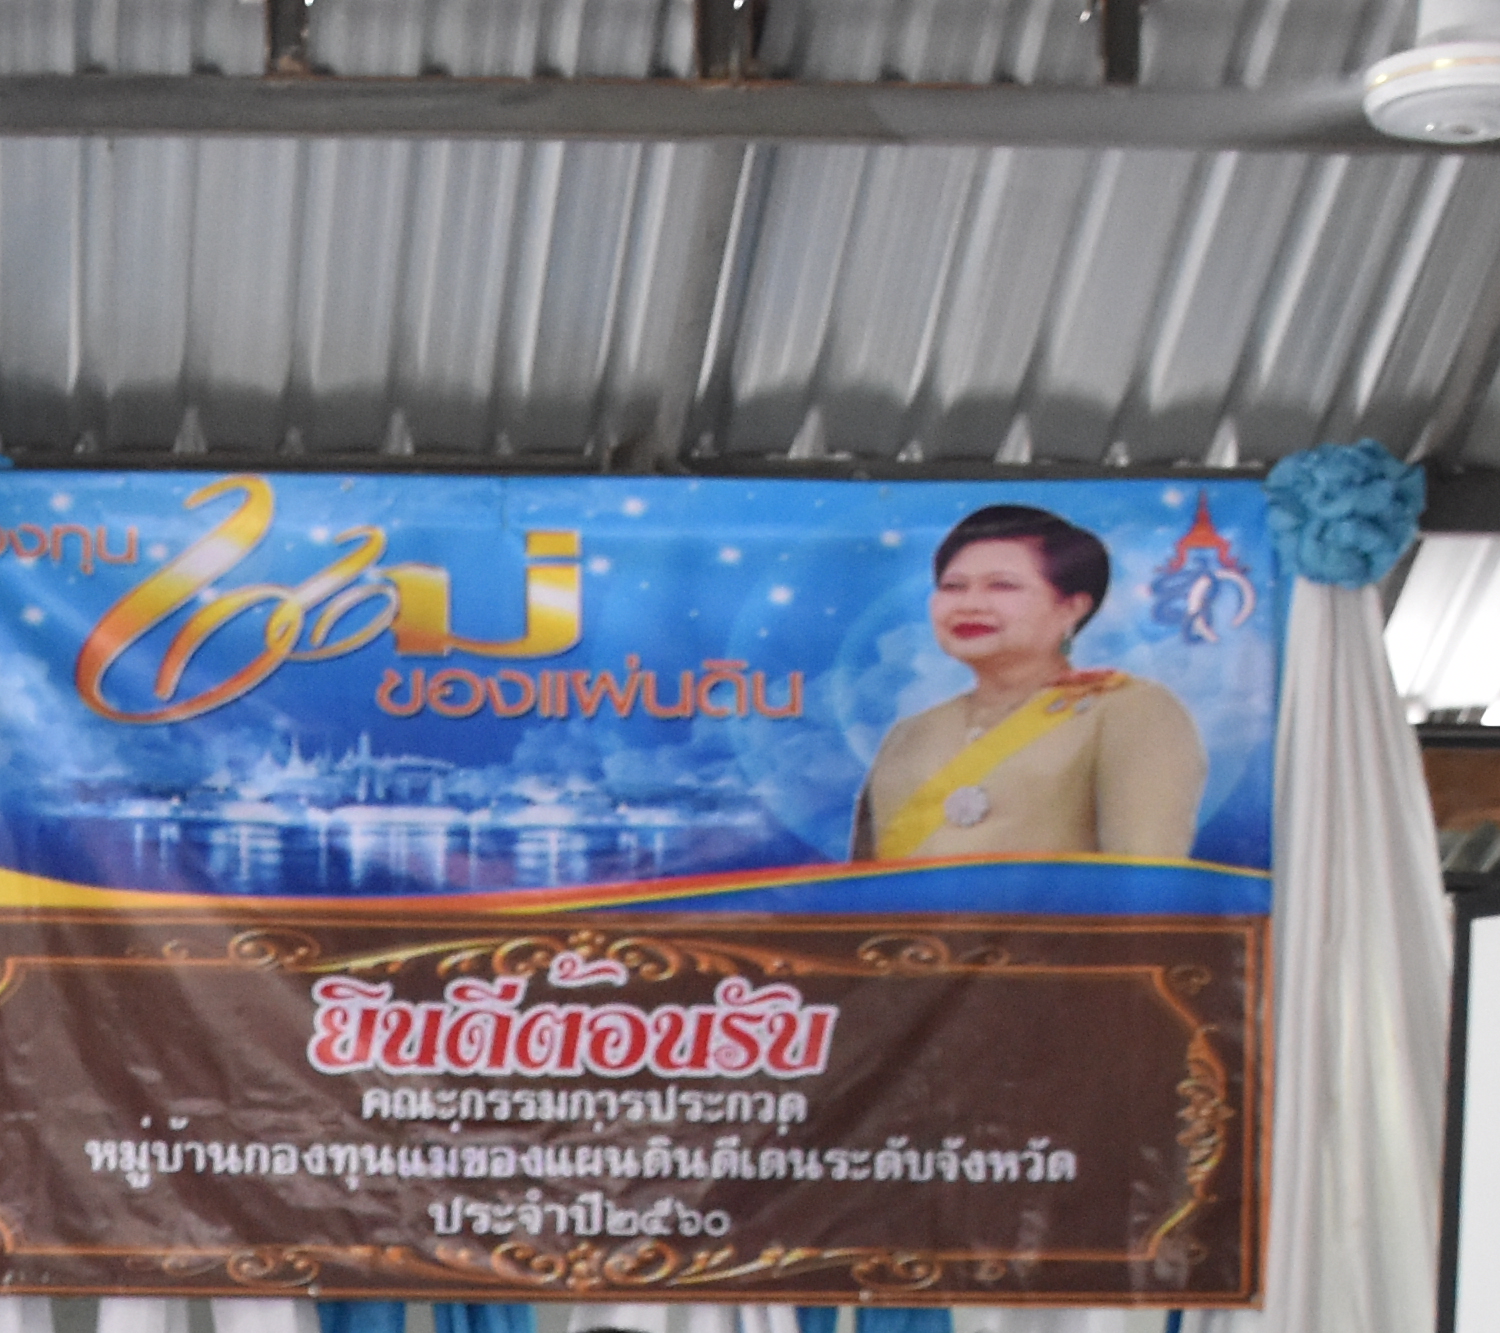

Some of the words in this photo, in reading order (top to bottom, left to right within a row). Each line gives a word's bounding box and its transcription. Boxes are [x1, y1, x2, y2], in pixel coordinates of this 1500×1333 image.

[376, 656, 803, 720] ของแผ่นดิน
[307, 951, 841, 1077] ยินดีต้อนรับ
[361, 1086, 808, 1121] คณะกรรมการประกวด
[84, 1116, 1077, 1188] หมู่บ้านกองทุนแม่ของแผ่นดินดีเด่นระดับจังหวัด
[428, 1189, 731, 1237] ประจำปี๒๕๖๐
